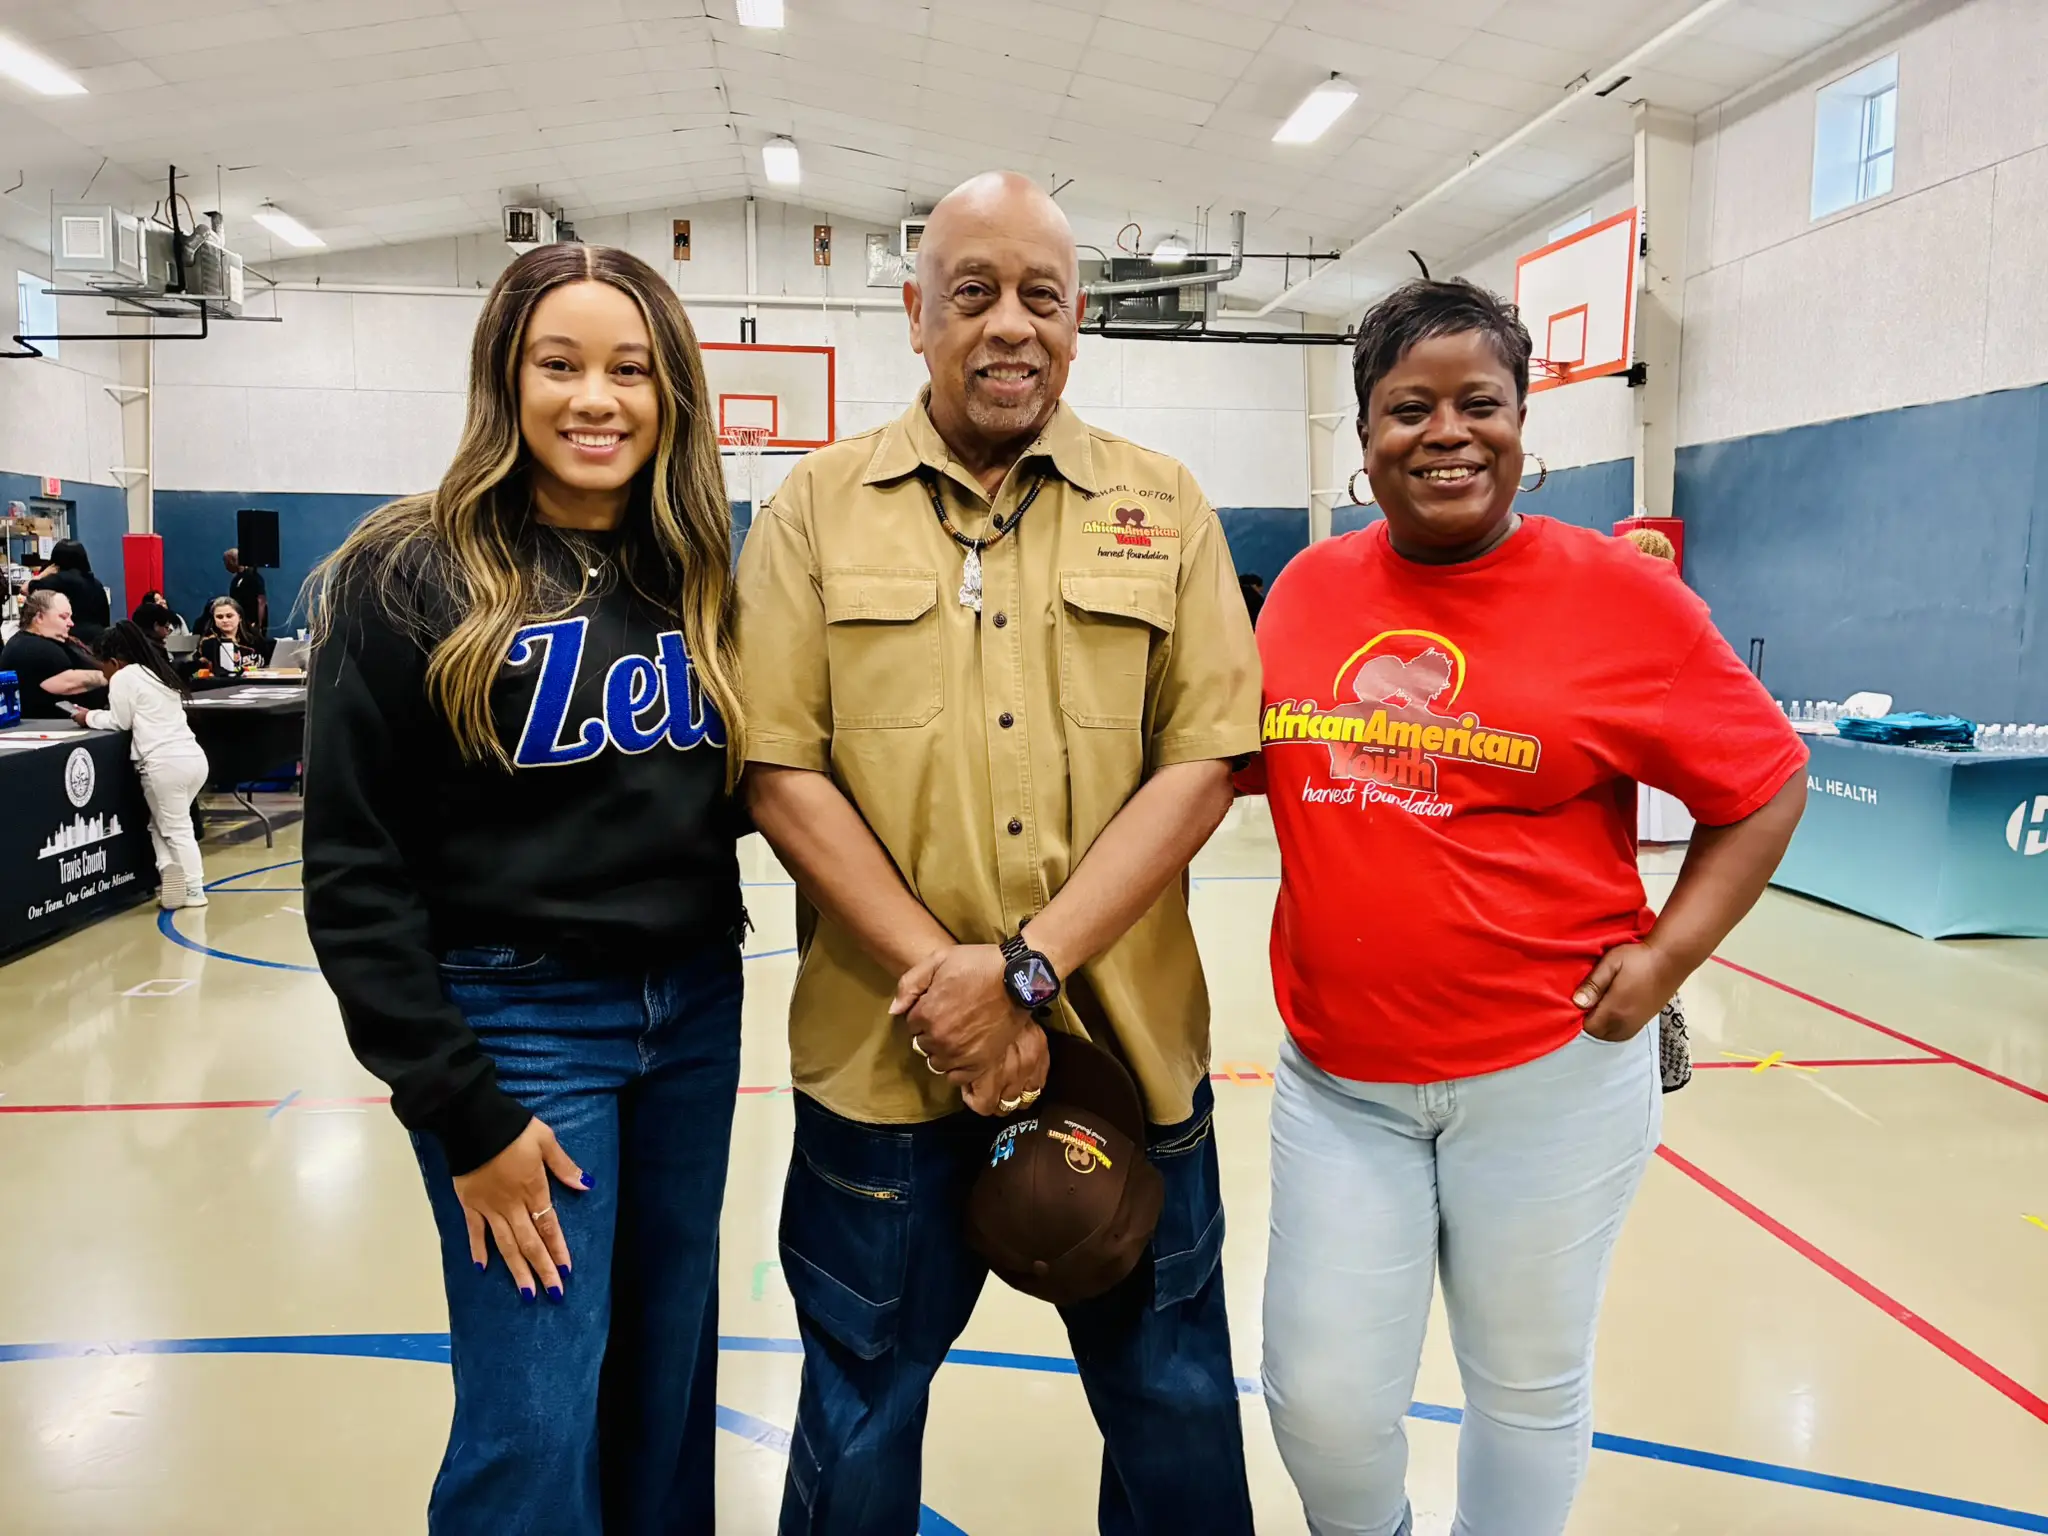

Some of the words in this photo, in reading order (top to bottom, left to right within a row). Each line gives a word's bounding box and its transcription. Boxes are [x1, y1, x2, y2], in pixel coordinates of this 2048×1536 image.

[1081, 485, 1129, 502] MICHAEL
[1133, 488, 1175, 503] LOFTON
[1126, 549, 1169, 560] foundation
[1330, 742, 1433, 789] Youth
[1302, 776, 1355, 805] harvest
[1361, 783, 1453, 817] foundation
[1826, 779, 1878, 805] HEALTH
[58, 854, 82, 884] Travis
[82, 846, 107, 876] County
[28, 905, 43, 920] One
[45, 899, 65, 914] Team.
[65, 892, 79, 906] One
[80, 882, 97, 900] Goal.
[98, 880, 111, 892] One
